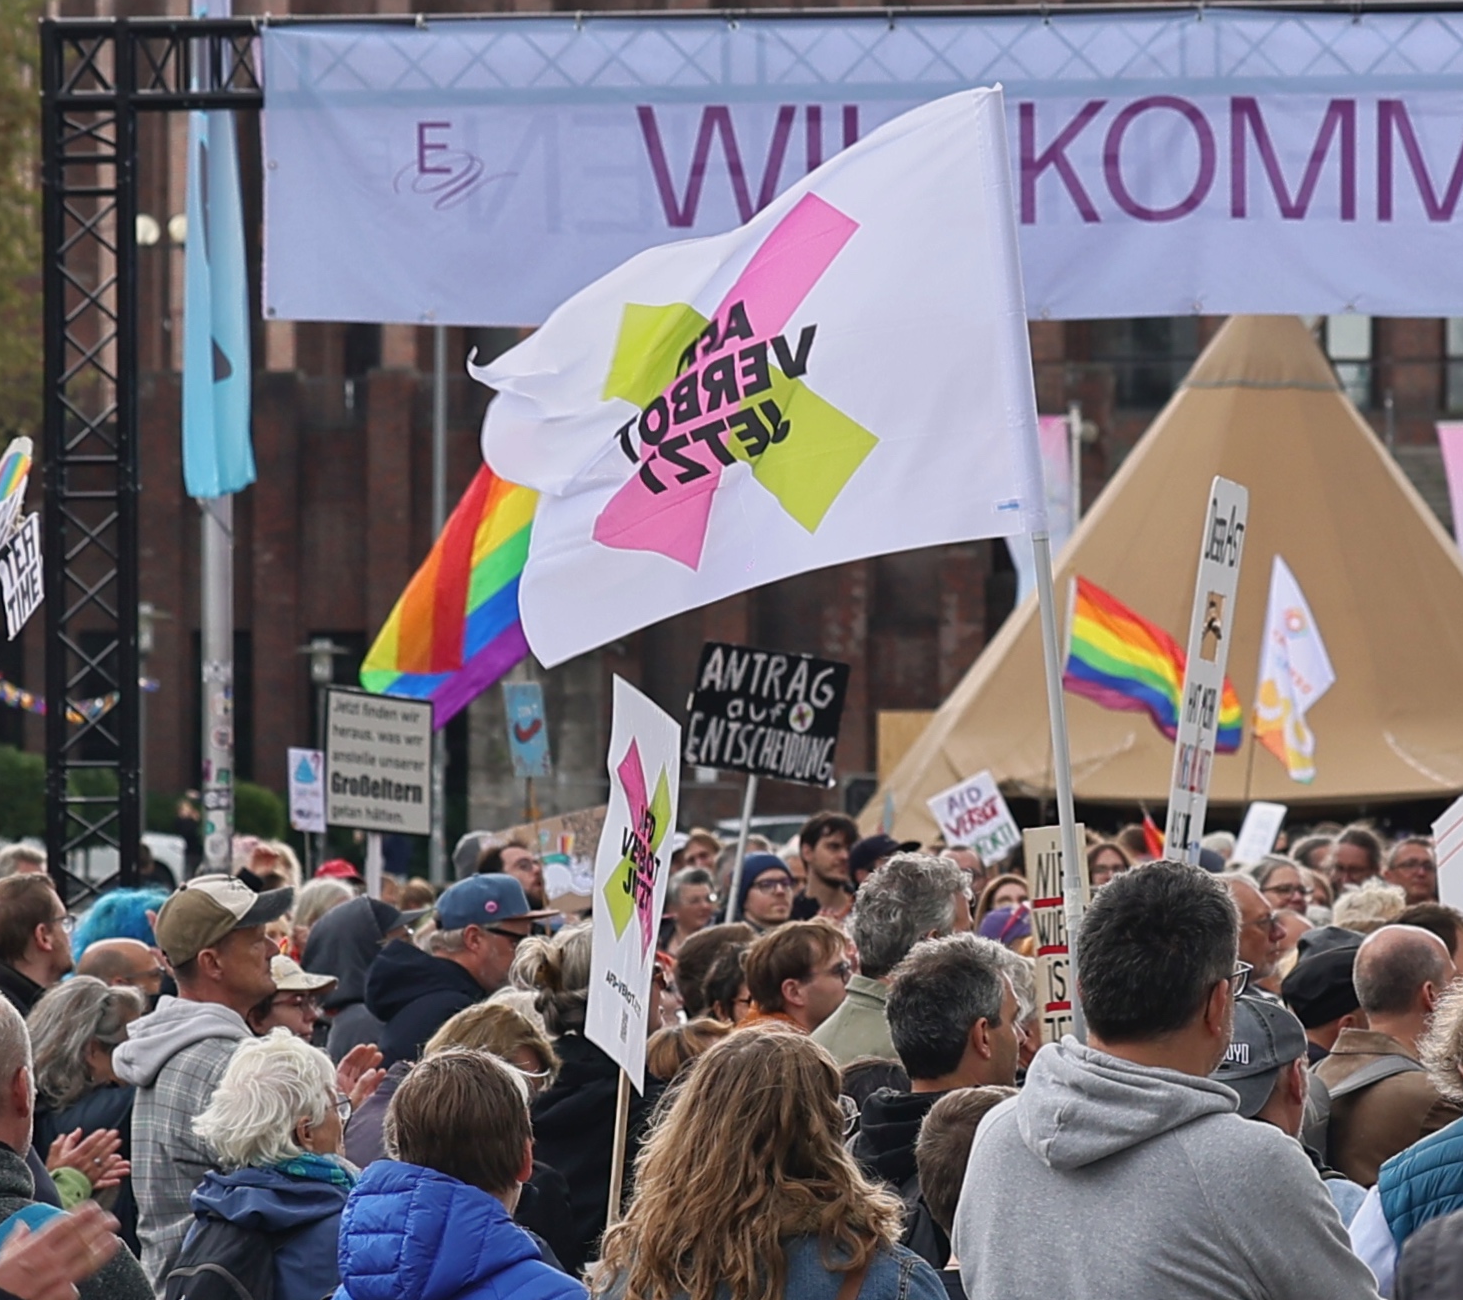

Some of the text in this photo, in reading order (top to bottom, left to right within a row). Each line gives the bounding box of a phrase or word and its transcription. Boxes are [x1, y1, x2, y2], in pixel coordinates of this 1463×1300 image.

[7, 562, 40, 636] TIME
[700, 645, 836, 710] ANTRAG
[362, 702, 398, 722] finden
[400, 710, 421, 724] wir
[726, 698, 787, 724] auf
[377, 731, 401, 745] was
[404, 733, 424, 747] wir
[683, 710, 836, 782] ENTSCHEIDUNG
[332, 749, 426, 773] anstelle unserer
[330, 771, 424, 805] Großeltern
[331, 805, 363, 821] getan
